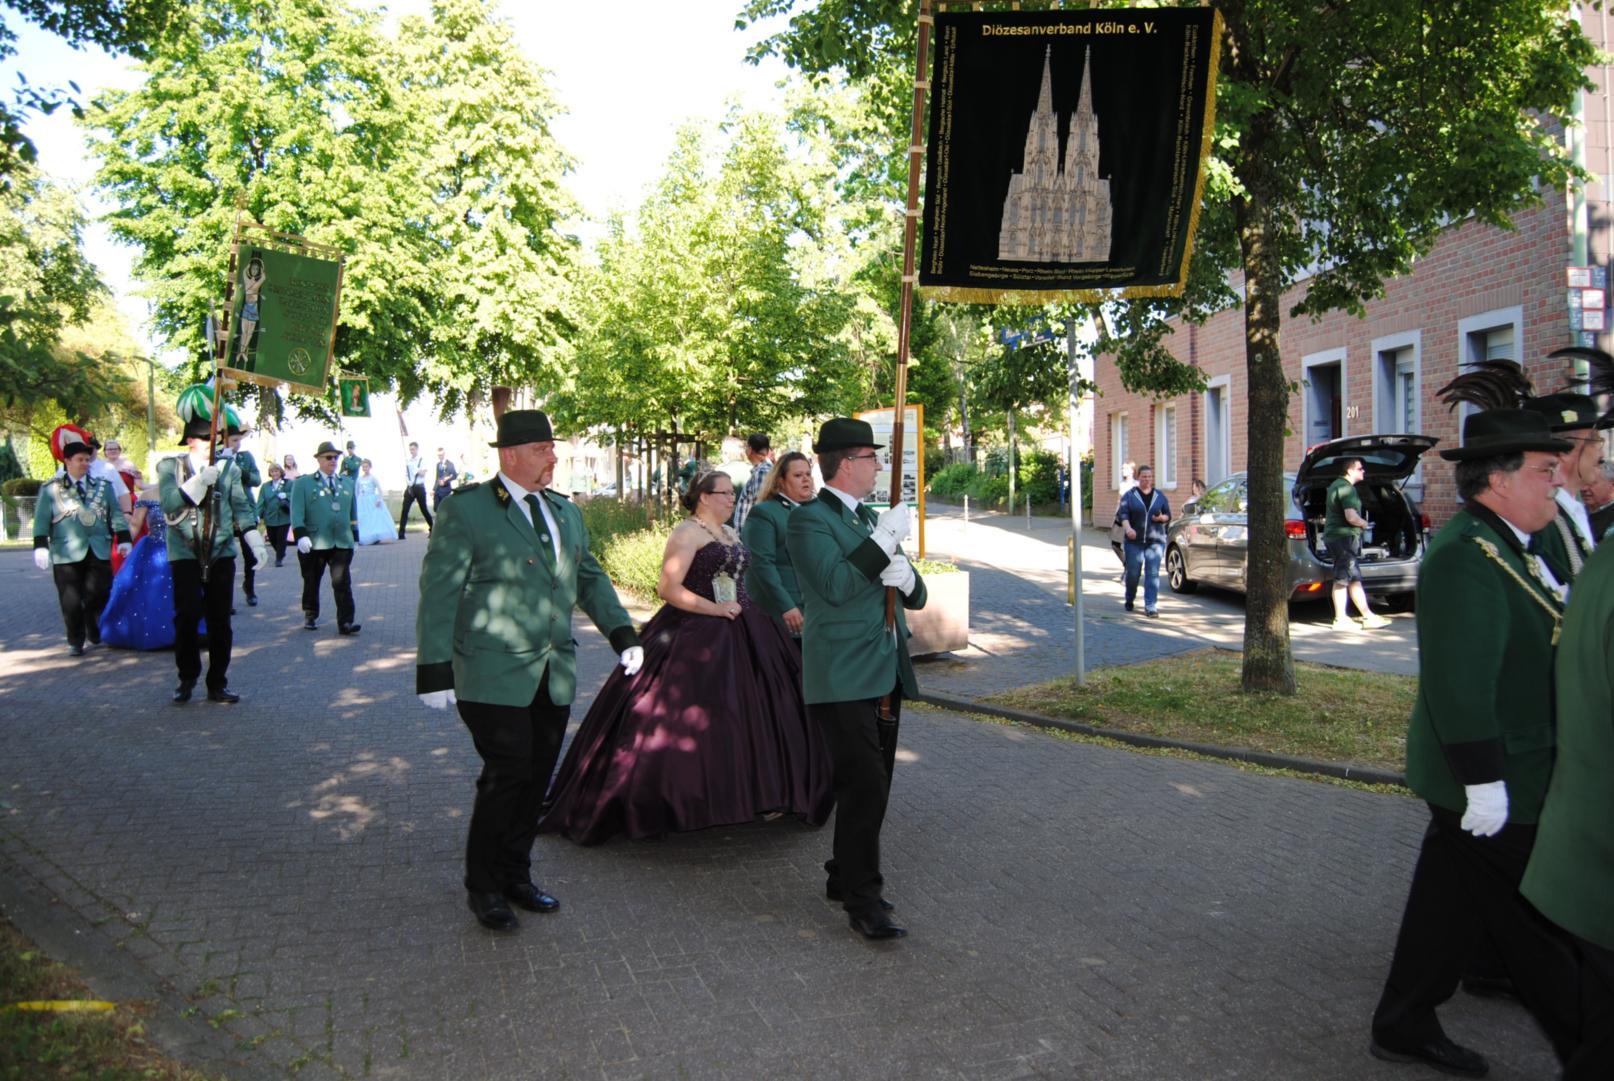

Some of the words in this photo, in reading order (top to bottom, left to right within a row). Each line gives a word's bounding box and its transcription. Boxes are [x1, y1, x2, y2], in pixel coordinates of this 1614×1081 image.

[982, 22, 1091, 36] Diözesanverband
[1095, 22, 1124, 35] Köln
[1128, 24, 1140, 35] e.
[1144, 22, 1158, 34] V.
[1346, 406, 1359, 419] 201
